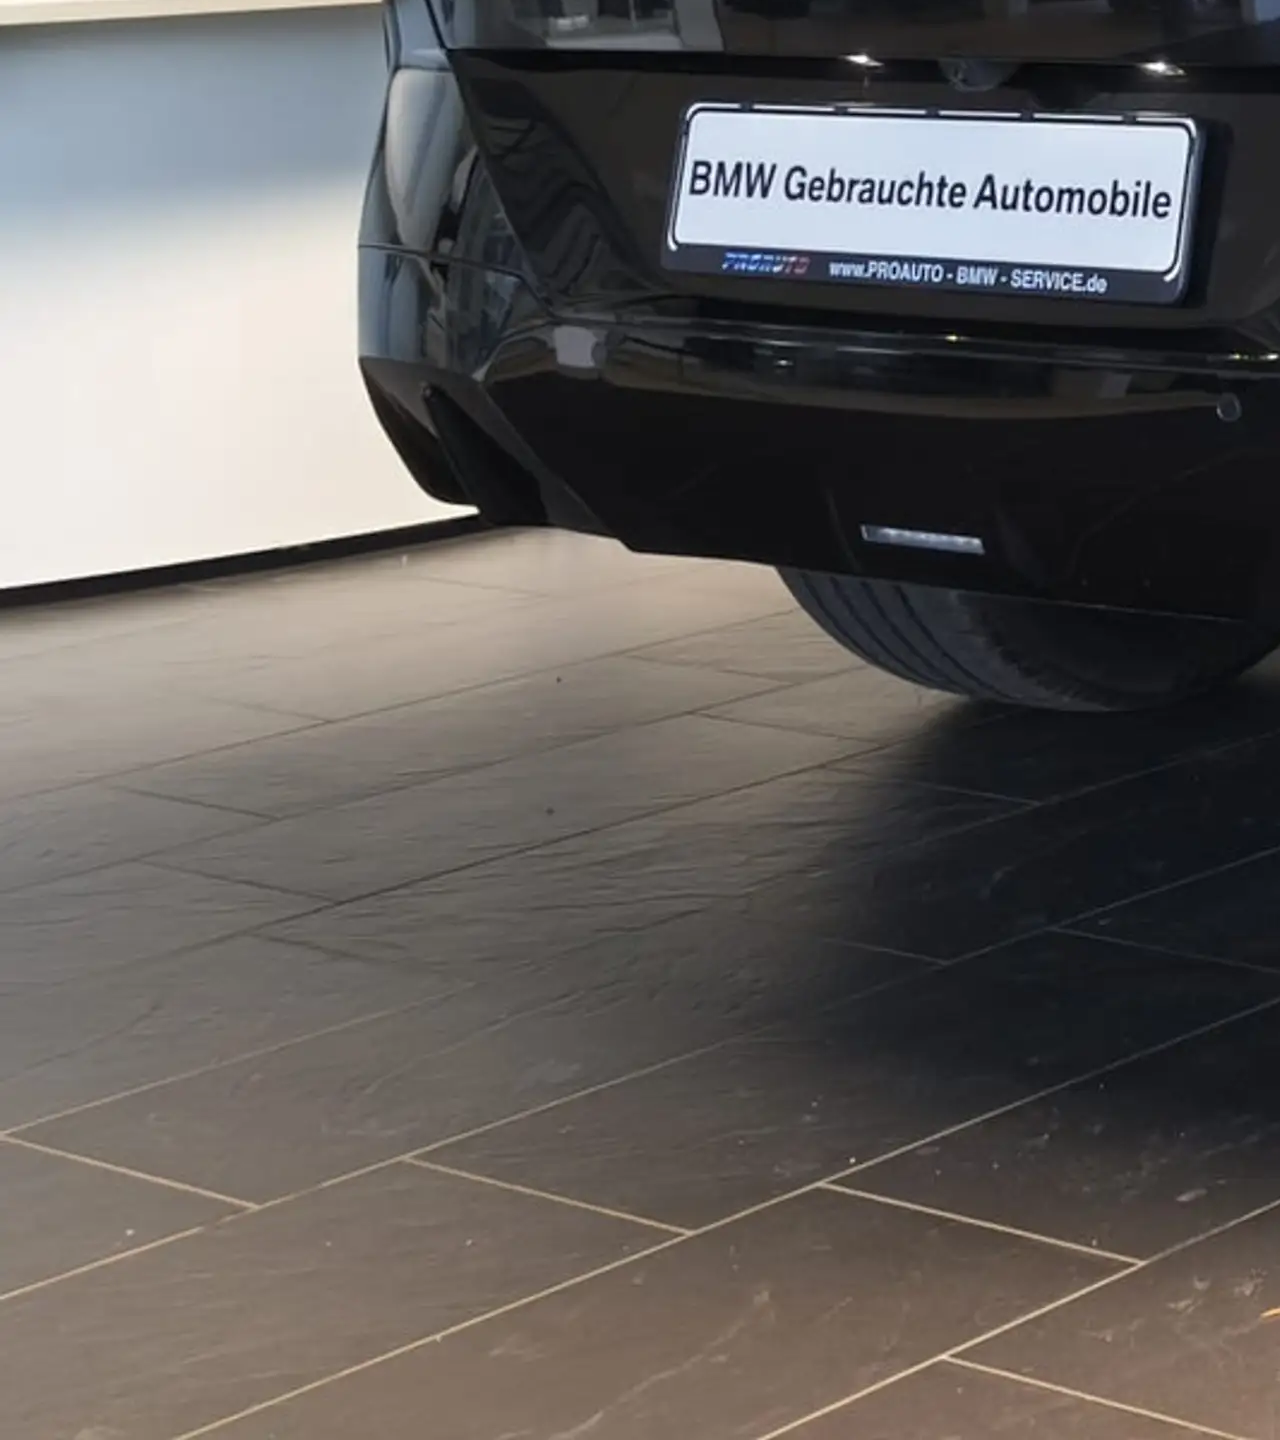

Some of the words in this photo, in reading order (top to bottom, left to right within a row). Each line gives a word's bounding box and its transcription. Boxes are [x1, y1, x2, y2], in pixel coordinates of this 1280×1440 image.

[689, 160, 777, 199] BMW
[784, 165, 967, 208] Gebrauchte
[973, 173, 1172, 218] Automobile
[829, 261, 944, 283] www.PROAUTO
[956, 266, 998, 285] BMW
[1010, 269, 1108, 294] SERVICE.de
